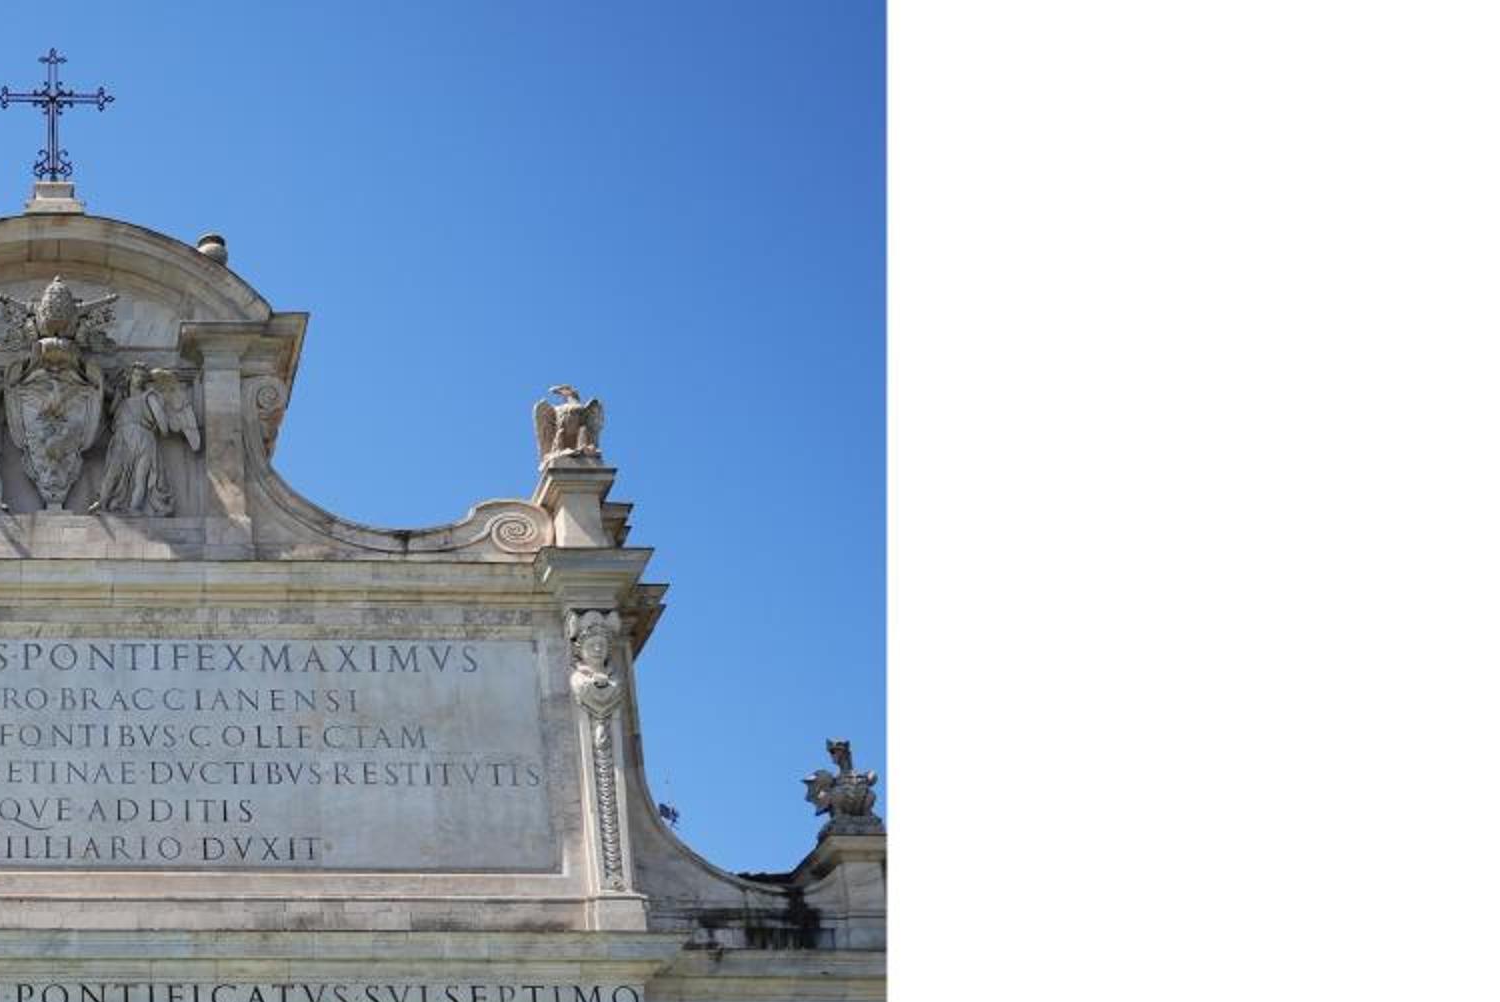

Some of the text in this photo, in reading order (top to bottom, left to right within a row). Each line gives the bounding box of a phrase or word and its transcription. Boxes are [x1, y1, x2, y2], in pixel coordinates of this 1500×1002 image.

[21, 642, 246, 672] PONTIFEX
[260, 644, 479, 673] MAXIMVS
[60, 687, 357, 713] BRACCIANENSI
[0, 723, 177, 748] FONTIBVS
[189, 725, 427, 749] COLLECTAM
[150, 761, 322, 785] DVCTIBVS
[334, 762, 540, 787] RESTITVTIS
[88, 799, 253, 823] ADDITIS
[202, 836, 323, 861] DVXIT
